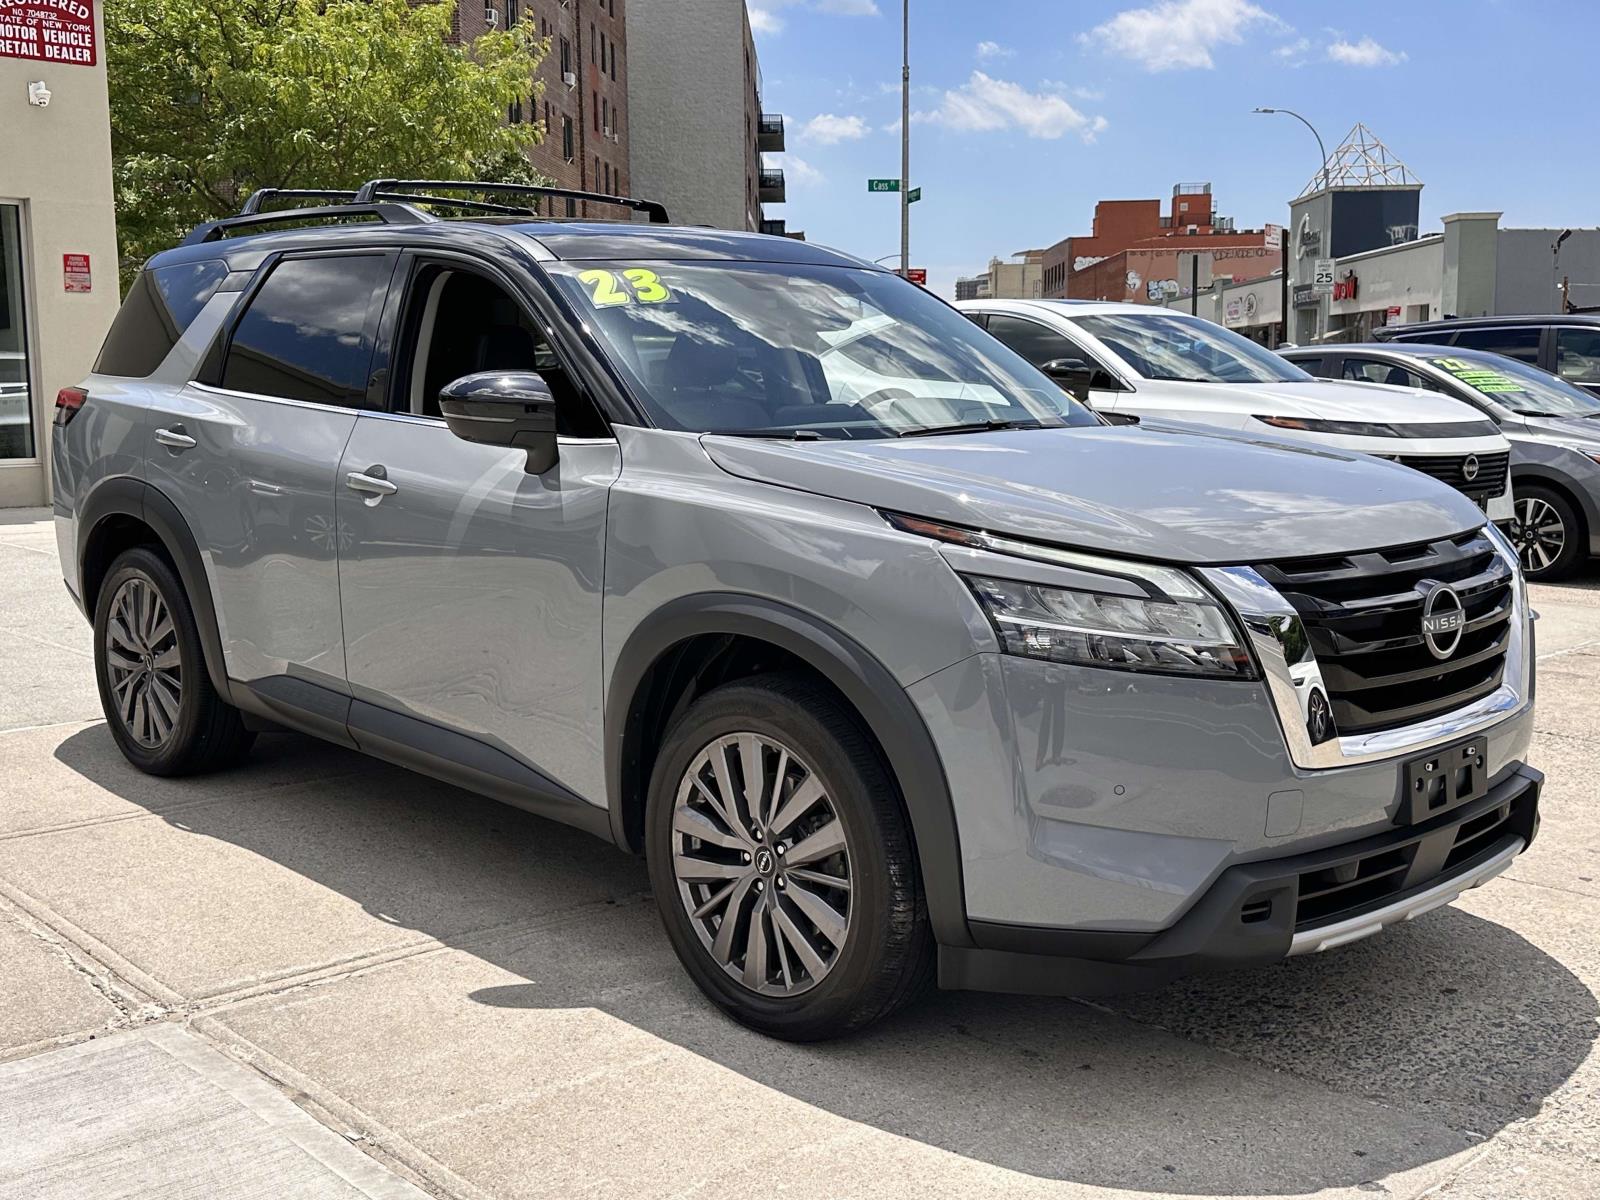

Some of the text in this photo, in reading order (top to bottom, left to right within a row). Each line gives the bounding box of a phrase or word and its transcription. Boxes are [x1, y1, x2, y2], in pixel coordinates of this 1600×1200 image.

[0, 15, 91, 32] TATE OF NEW YORK
[43, 29, 92, 47] VEHICLE
[0, 39, 91, 62] RETAIL DEALER
[873, 181, 888, 190] Cass
[1316, 273, 1333, 283] 25
[578, 268, 671, 308] 23
